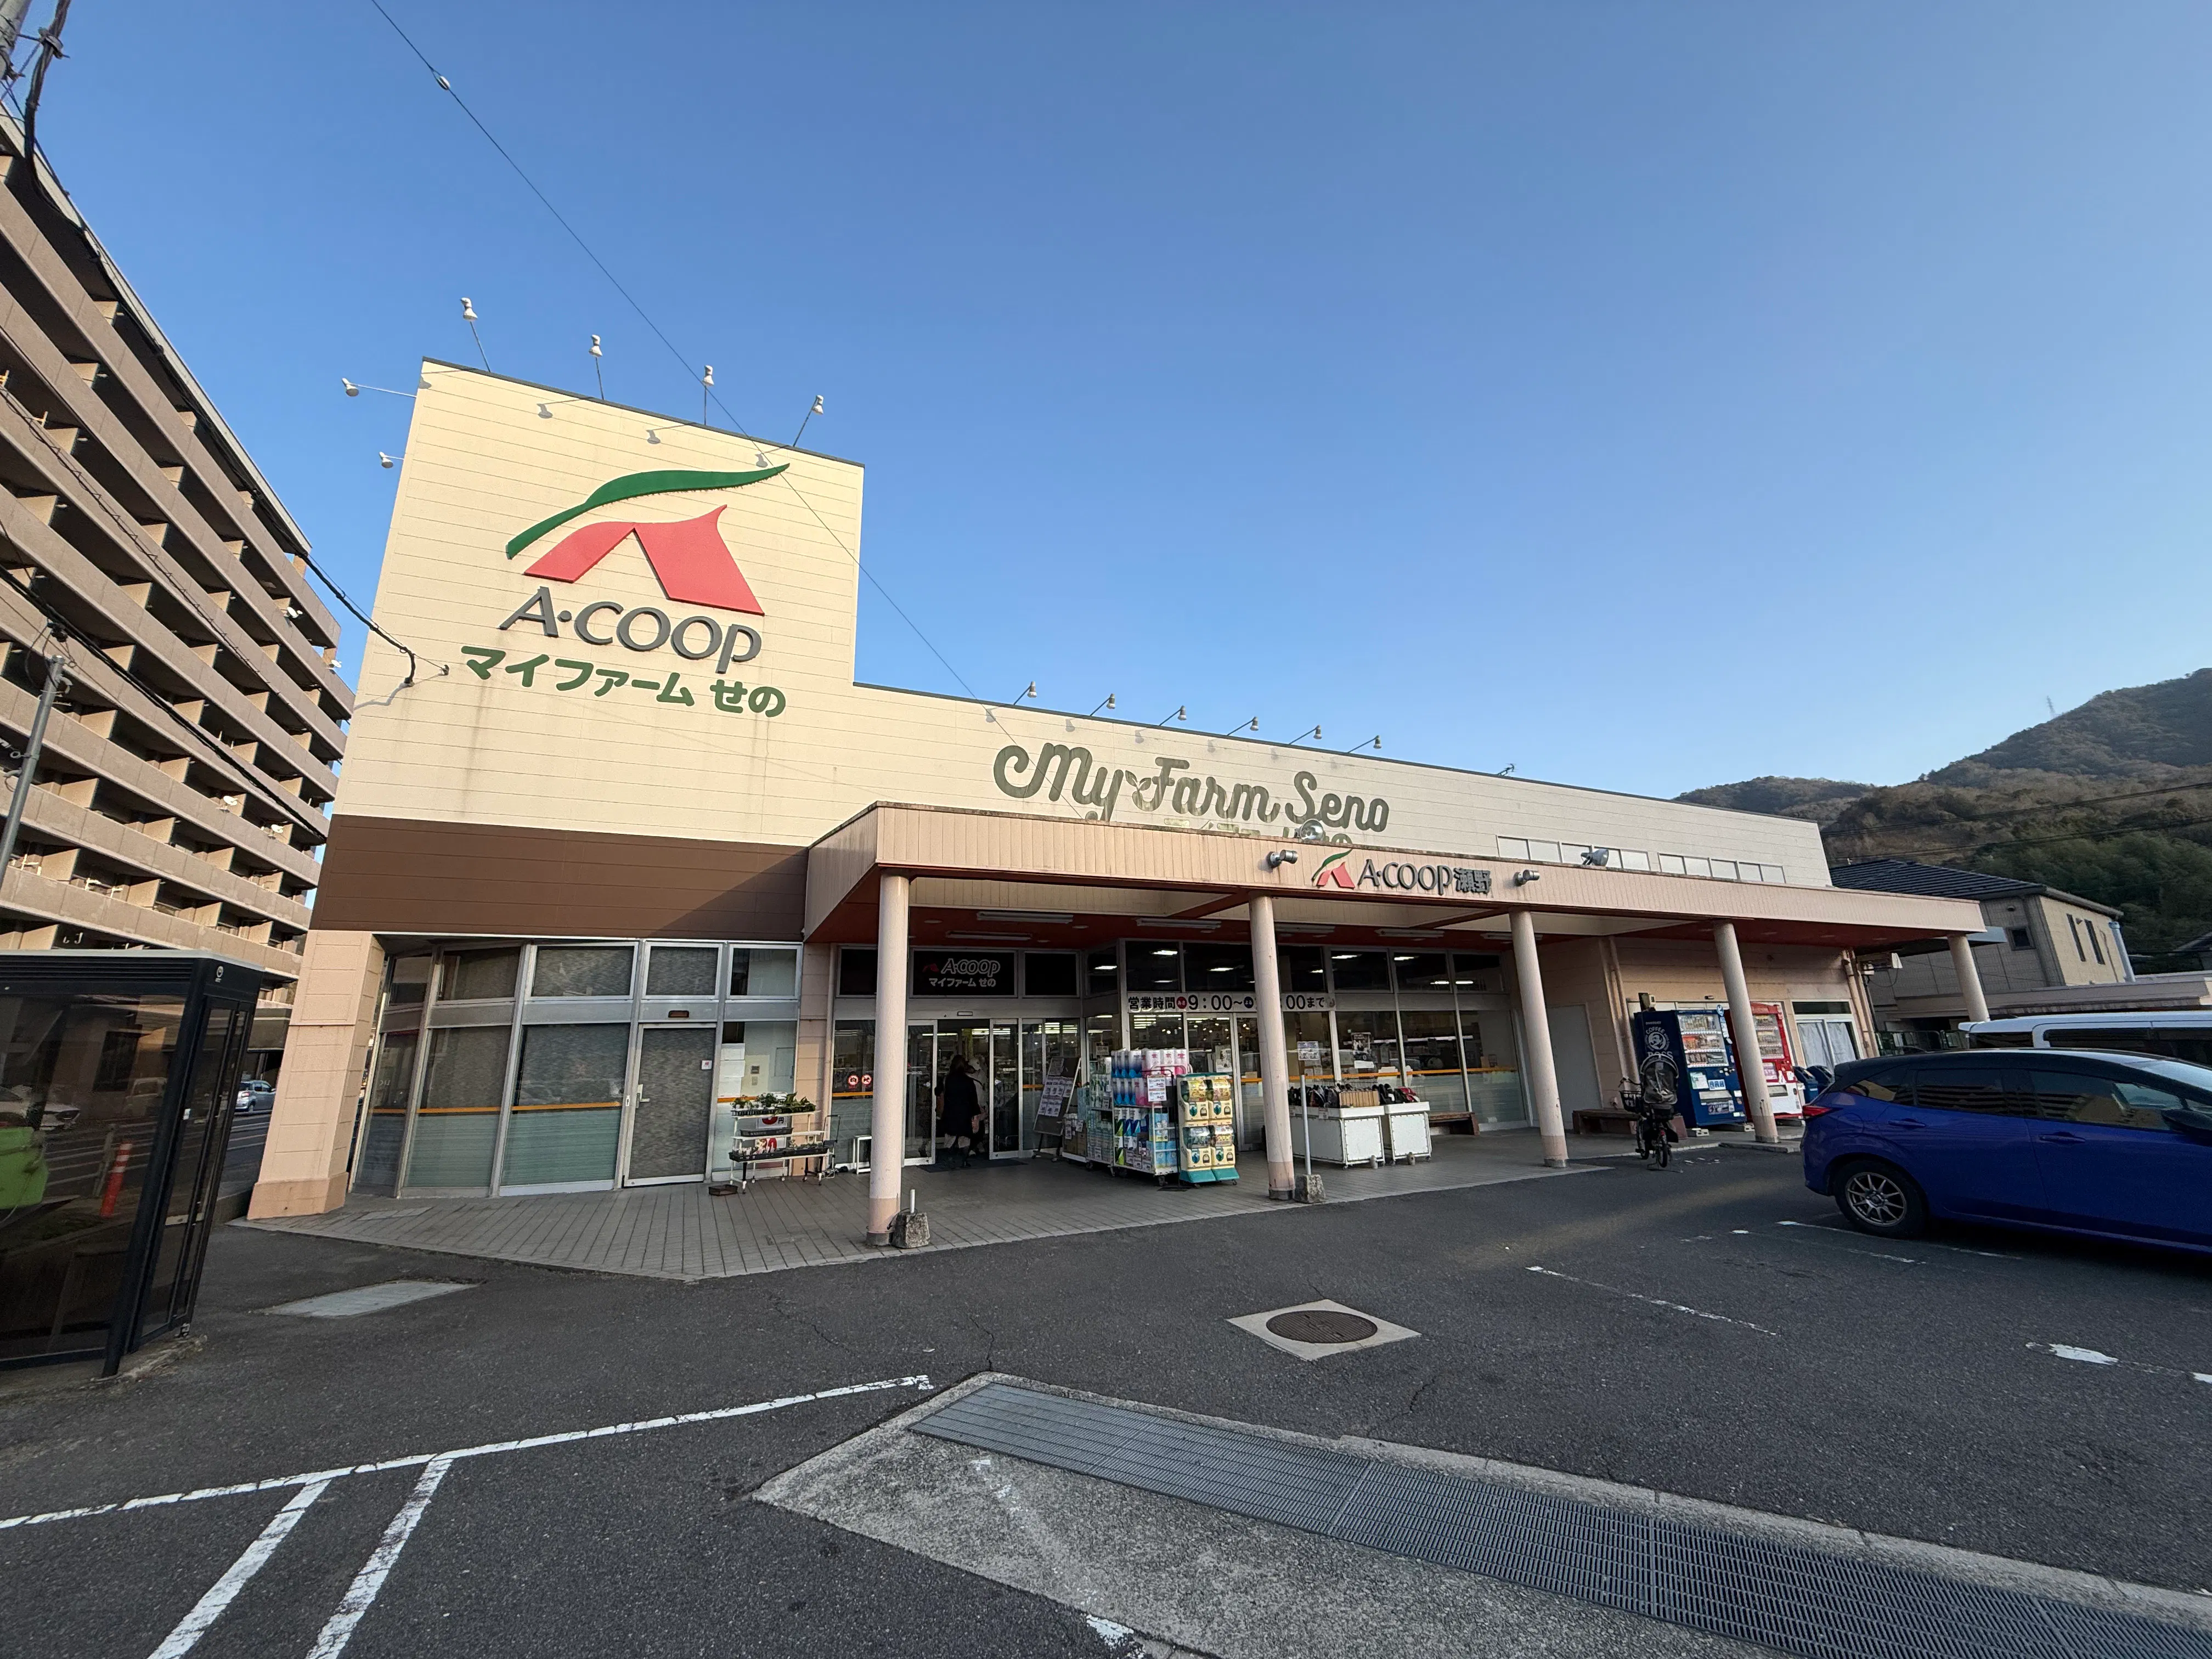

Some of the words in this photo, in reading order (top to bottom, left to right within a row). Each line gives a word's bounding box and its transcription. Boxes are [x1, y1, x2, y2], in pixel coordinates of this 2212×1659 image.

[461, 645, 695, 707] マイファーム
[710, 679, 786, 718] せの
[994, 742, 1125, 821] My
[1131, 757, 1281, 823] Farm
[1285, 771, 1390, 833] Seno
[929, 978, 976, 987] マイファーム
[979, 978, 996, 987] せの
[1128, 996, 1176, 1009] 営業時間
